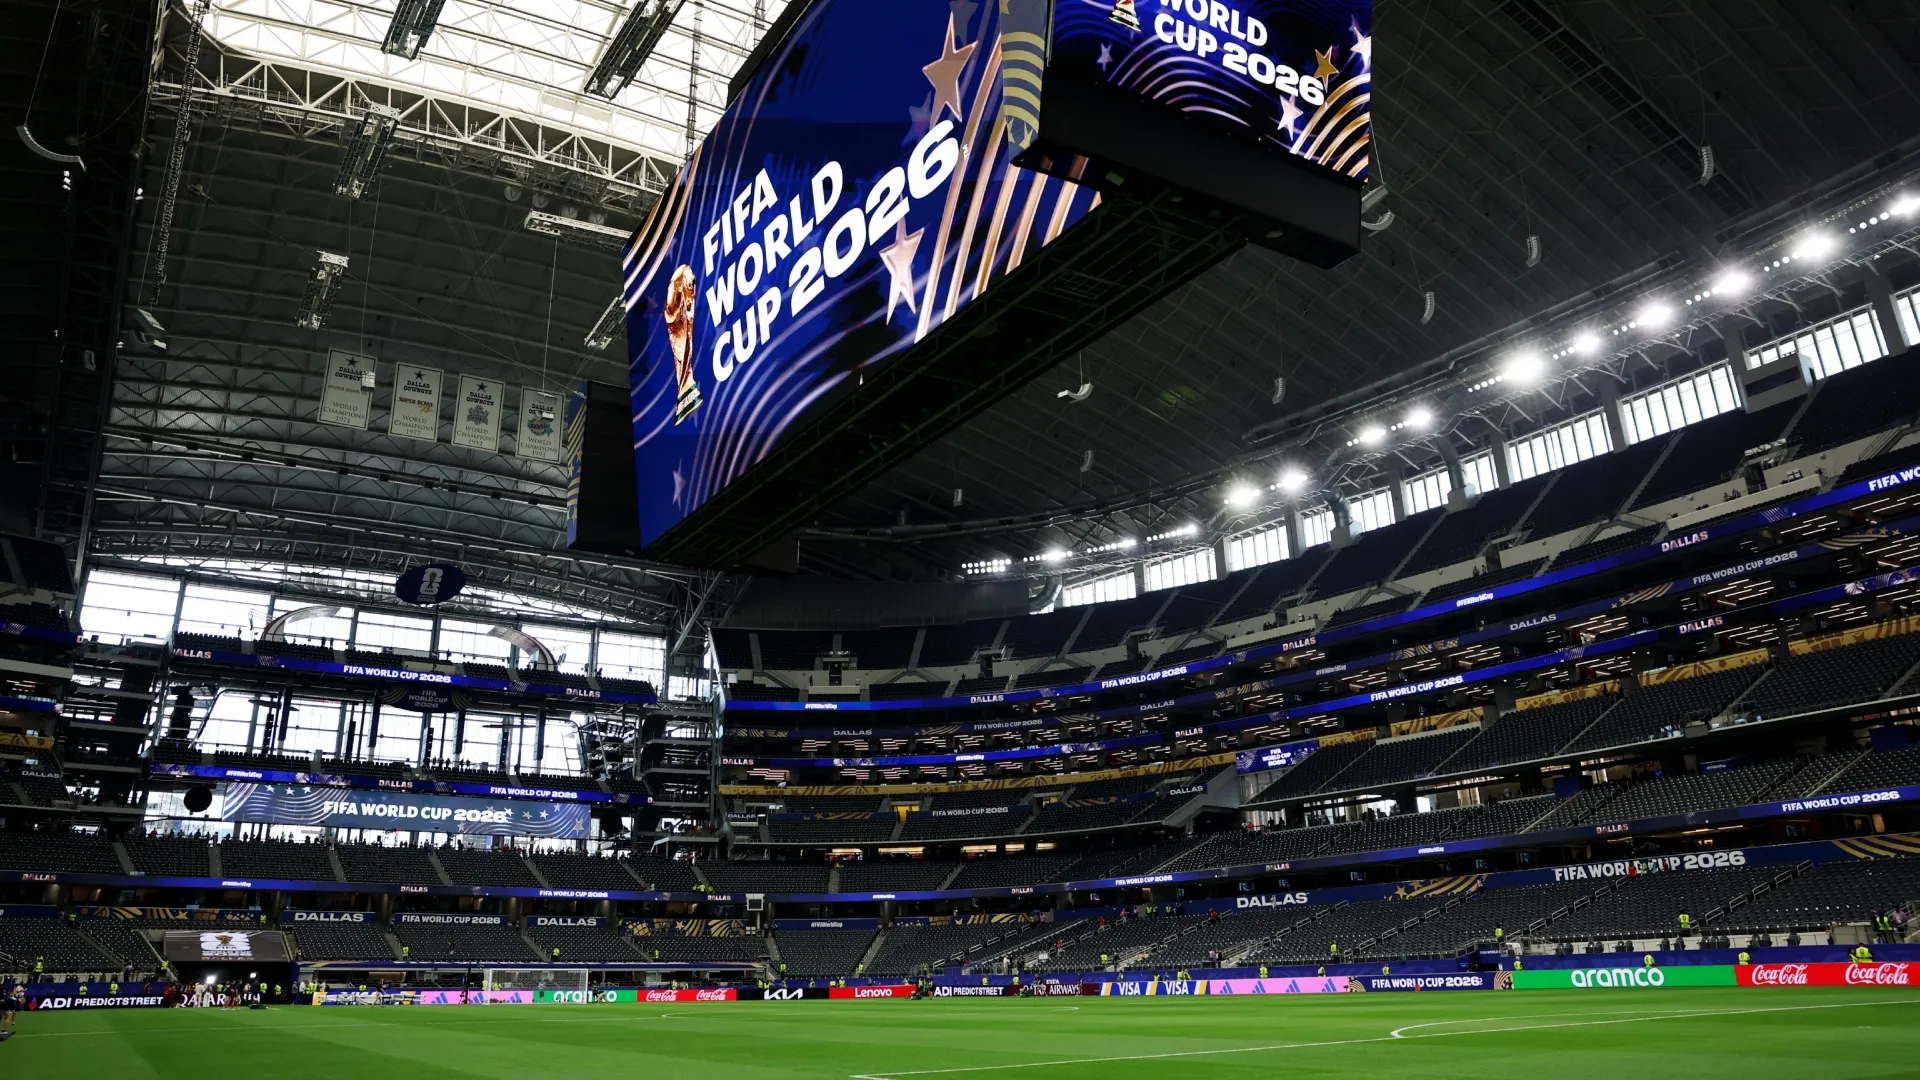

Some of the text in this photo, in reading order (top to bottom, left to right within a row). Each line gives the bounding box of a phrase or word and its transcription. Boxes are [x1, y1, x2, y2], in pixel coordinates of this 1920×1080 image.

[1154, 13, 1325, 107] CUP 2026
[703, 168, 778, 276] FIFA
[705, 160, 844, 327] WORLD
[712, 119, 961, 382] CUP 2026
[407, 380, 431, 389] DALLAS
[403, 386, 432, 395] COWBOYS
[466, 397, 494, 407] COWBOYS
[470, 392, 492, 401] DALLAS
[333, 401, 358, 412] WORLD
[531, 403, 553, 412] DALLAS
[323, 406, 365, 420] CHAMPIONS
[402, 414, 427, 424] WORLD
[394, 420, 434, 432] CHAMPIONS
[465, 425, 488, 435] WORLD
[406, 428, 421, 436] 1977
[457, 430, 495, 442] CHAMPIONS
[528, 436, 551, 446] WORLD
[521, 442, 557, 453] CHAMPIONS
[1869, 474, 1900, 492] FIFA
[1661, 531, 1709, 552] DALLAS
[1693, 550, 1798, 585] FIFA WORLD CUP 2026
[1509, 613, 1557, 631] DALLAS
[1679, 616, 1723, 635] DALLAS
[1283, 637, 1316, 651] DALLAS
[173, 648, 212, 659] ALLAS
[343, 665, 452, 684] FIFA WORLD CUP 2026
[1101, 666, 1188, 689] FIFA WORLD CUP 2026
[566, 687, 601, 698] DALLAS
[1370, 675, 1464, 701] FIFA WORLD CUP 2026
[408, 695, 434, 703] WORLD
[970, 694, 1004, 704] DALLAS
[1140, 699, 1175, 711] DALLAS
[1022, 718, 1043, 726] 2026
[1175, 727, 1203, 738] DALLAS
[722, 758, 754, 766] DALLAS
[1262, 754, 1280, 762] WORLD
[22, 770, 60, 779] DALLAS
[378, 779, 413, 789] DALLAS
[490, 786, 578, 799] FIFA WORLD CUP 2026
[1170, 785, 1204, 796] DALLAS
[1782, 791, 1900, 812] FIFA WORLD CUP 2026
[322, 801, 508, 824] FIFA WORLD CUP 2026
[985, 806, 1009, 814] 2026
[1596, 823, 1629, 834] DALLAS
[1266, 863, 1289, 872] DALLAS
[1554, 866, 1587, 882] FIFA
[1684, 851, 1746, 870] 2026
[22, 873, 57, 881] DALLAS
[1126, 877, 1144, 885] WORLD
[1144, 876, 1155, 884] CUP
[1155, 875, 1173, 883] 2026
[1011, 887, 1034, 895] DALLAS
[1237, 892, 1308, 908] DALLAS
[294, 912, 365, 922] DALLAS
[402, 914, 501, 924] FIFA WORLD CUP 2026
[537, 917, 597, 926] DALLAS
[1571, 967, 1665, 988] aramco
[1752, 964, 1809, 986] Coca-Cola
[1845, 962, 1910, 986] Coca-Cola
[1166, 980, 1188, 995] VISA
[1372, 979, 1391, 989] FIFA
[1392, 977, 1424, 988] WORLD
[1426, 977, 1445, 988] CUP
[1445, 976, 1480, 987] 2026
[855, 987, 892, 998] Lenovo
[934, 986, 1004, 997] ADI PREDICTSTREET
[1049, 984, 1080, 995] AIRWAYS
[1119, 982, 1141, 996] VISA
[554, 990, 617, 1003] aramo
[646, 989, 678, 1002] Coca-Cola
[696, 989, 728, 1002] Coca-Cola
[39, 996, 164, 1009] ADI PREDICTSTREET
